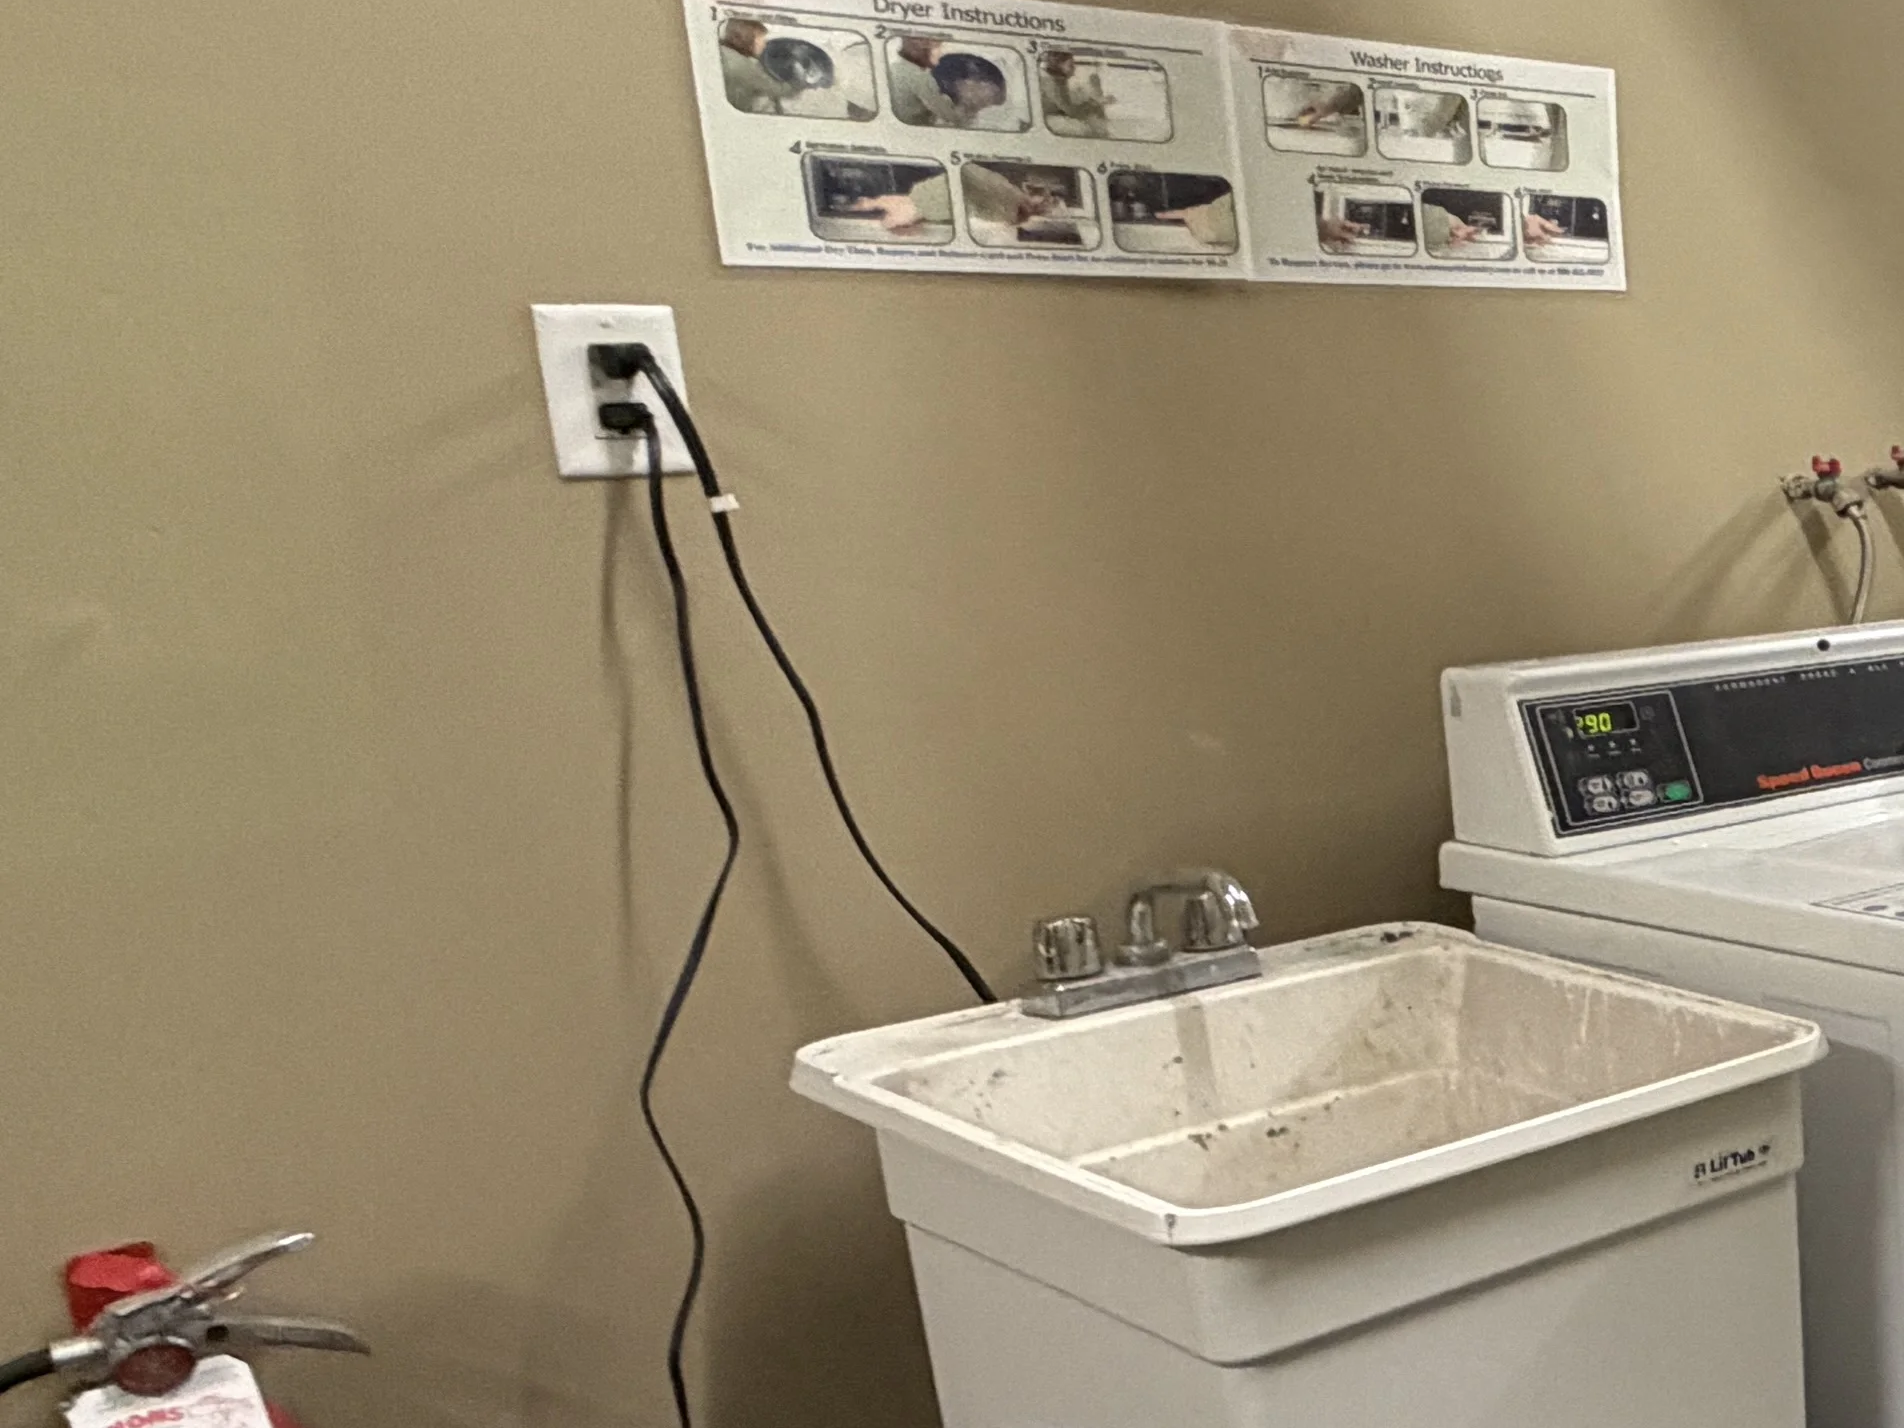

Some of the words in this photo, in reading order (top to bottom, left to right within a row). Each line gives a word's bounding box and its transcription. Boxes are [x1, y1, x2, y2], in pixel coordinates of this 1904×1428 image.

[942, 2, 1067, 32] Instructions
[874, 25, 886, 39] 2
[1026, 39, 1038, 54] 3
[1350, 50, 1410, 71] Washer
[1415, 57, 1504, 82] Instructions
